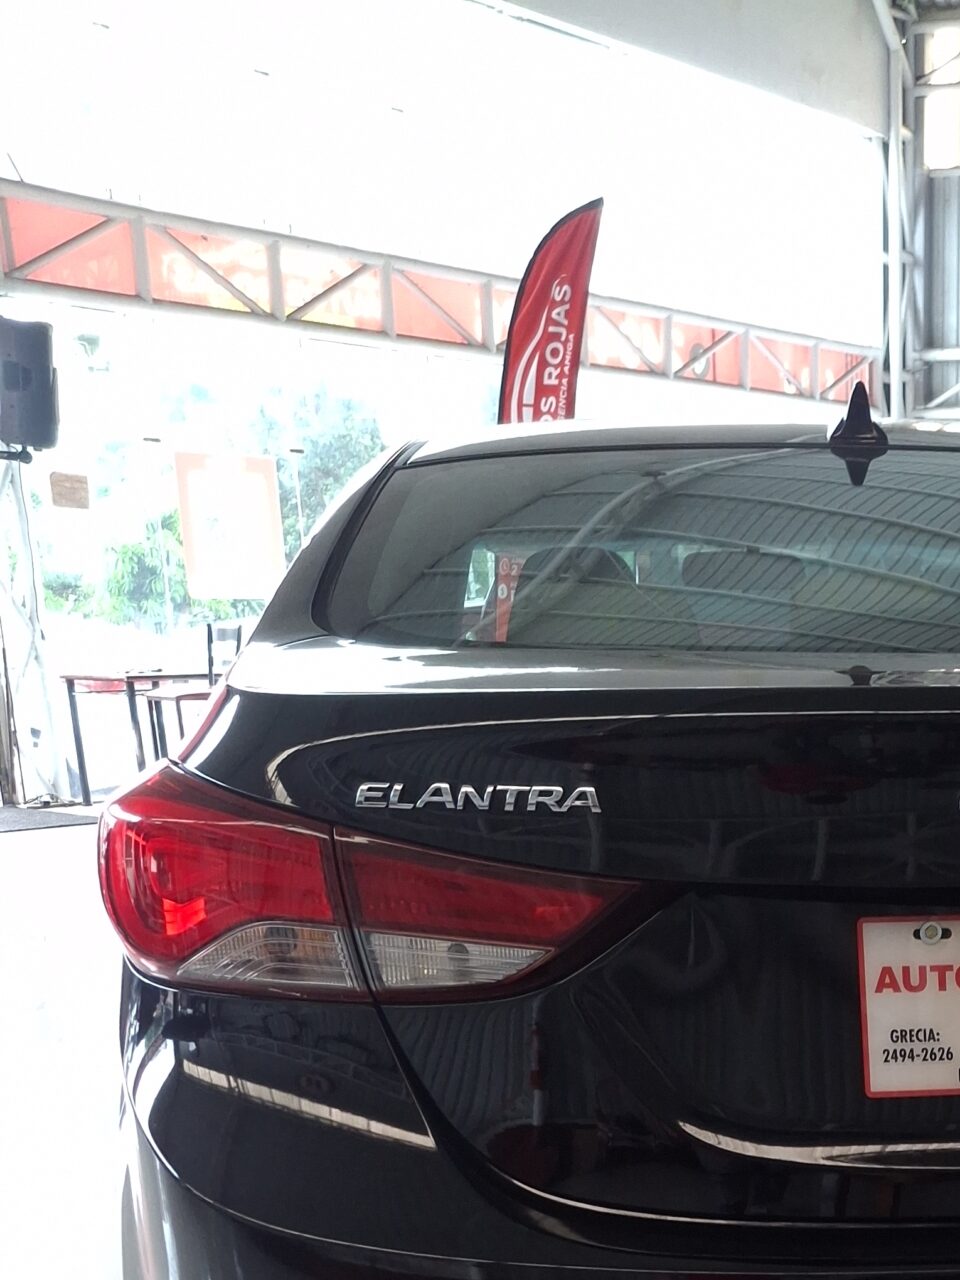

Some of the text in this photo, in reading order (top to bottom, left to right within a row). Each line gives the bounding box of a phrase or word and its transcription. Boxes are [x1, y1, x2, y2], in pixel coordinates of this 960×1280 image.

[543, 284, 572, 385] ROJAS
[563, 333, 575, 376] AMIGA
[355, 781, 602, 813] ELANTRA
[890, 1028, 940, 1043] GRECIA:
[882, 1047, 954, 1063] 2494-2626
